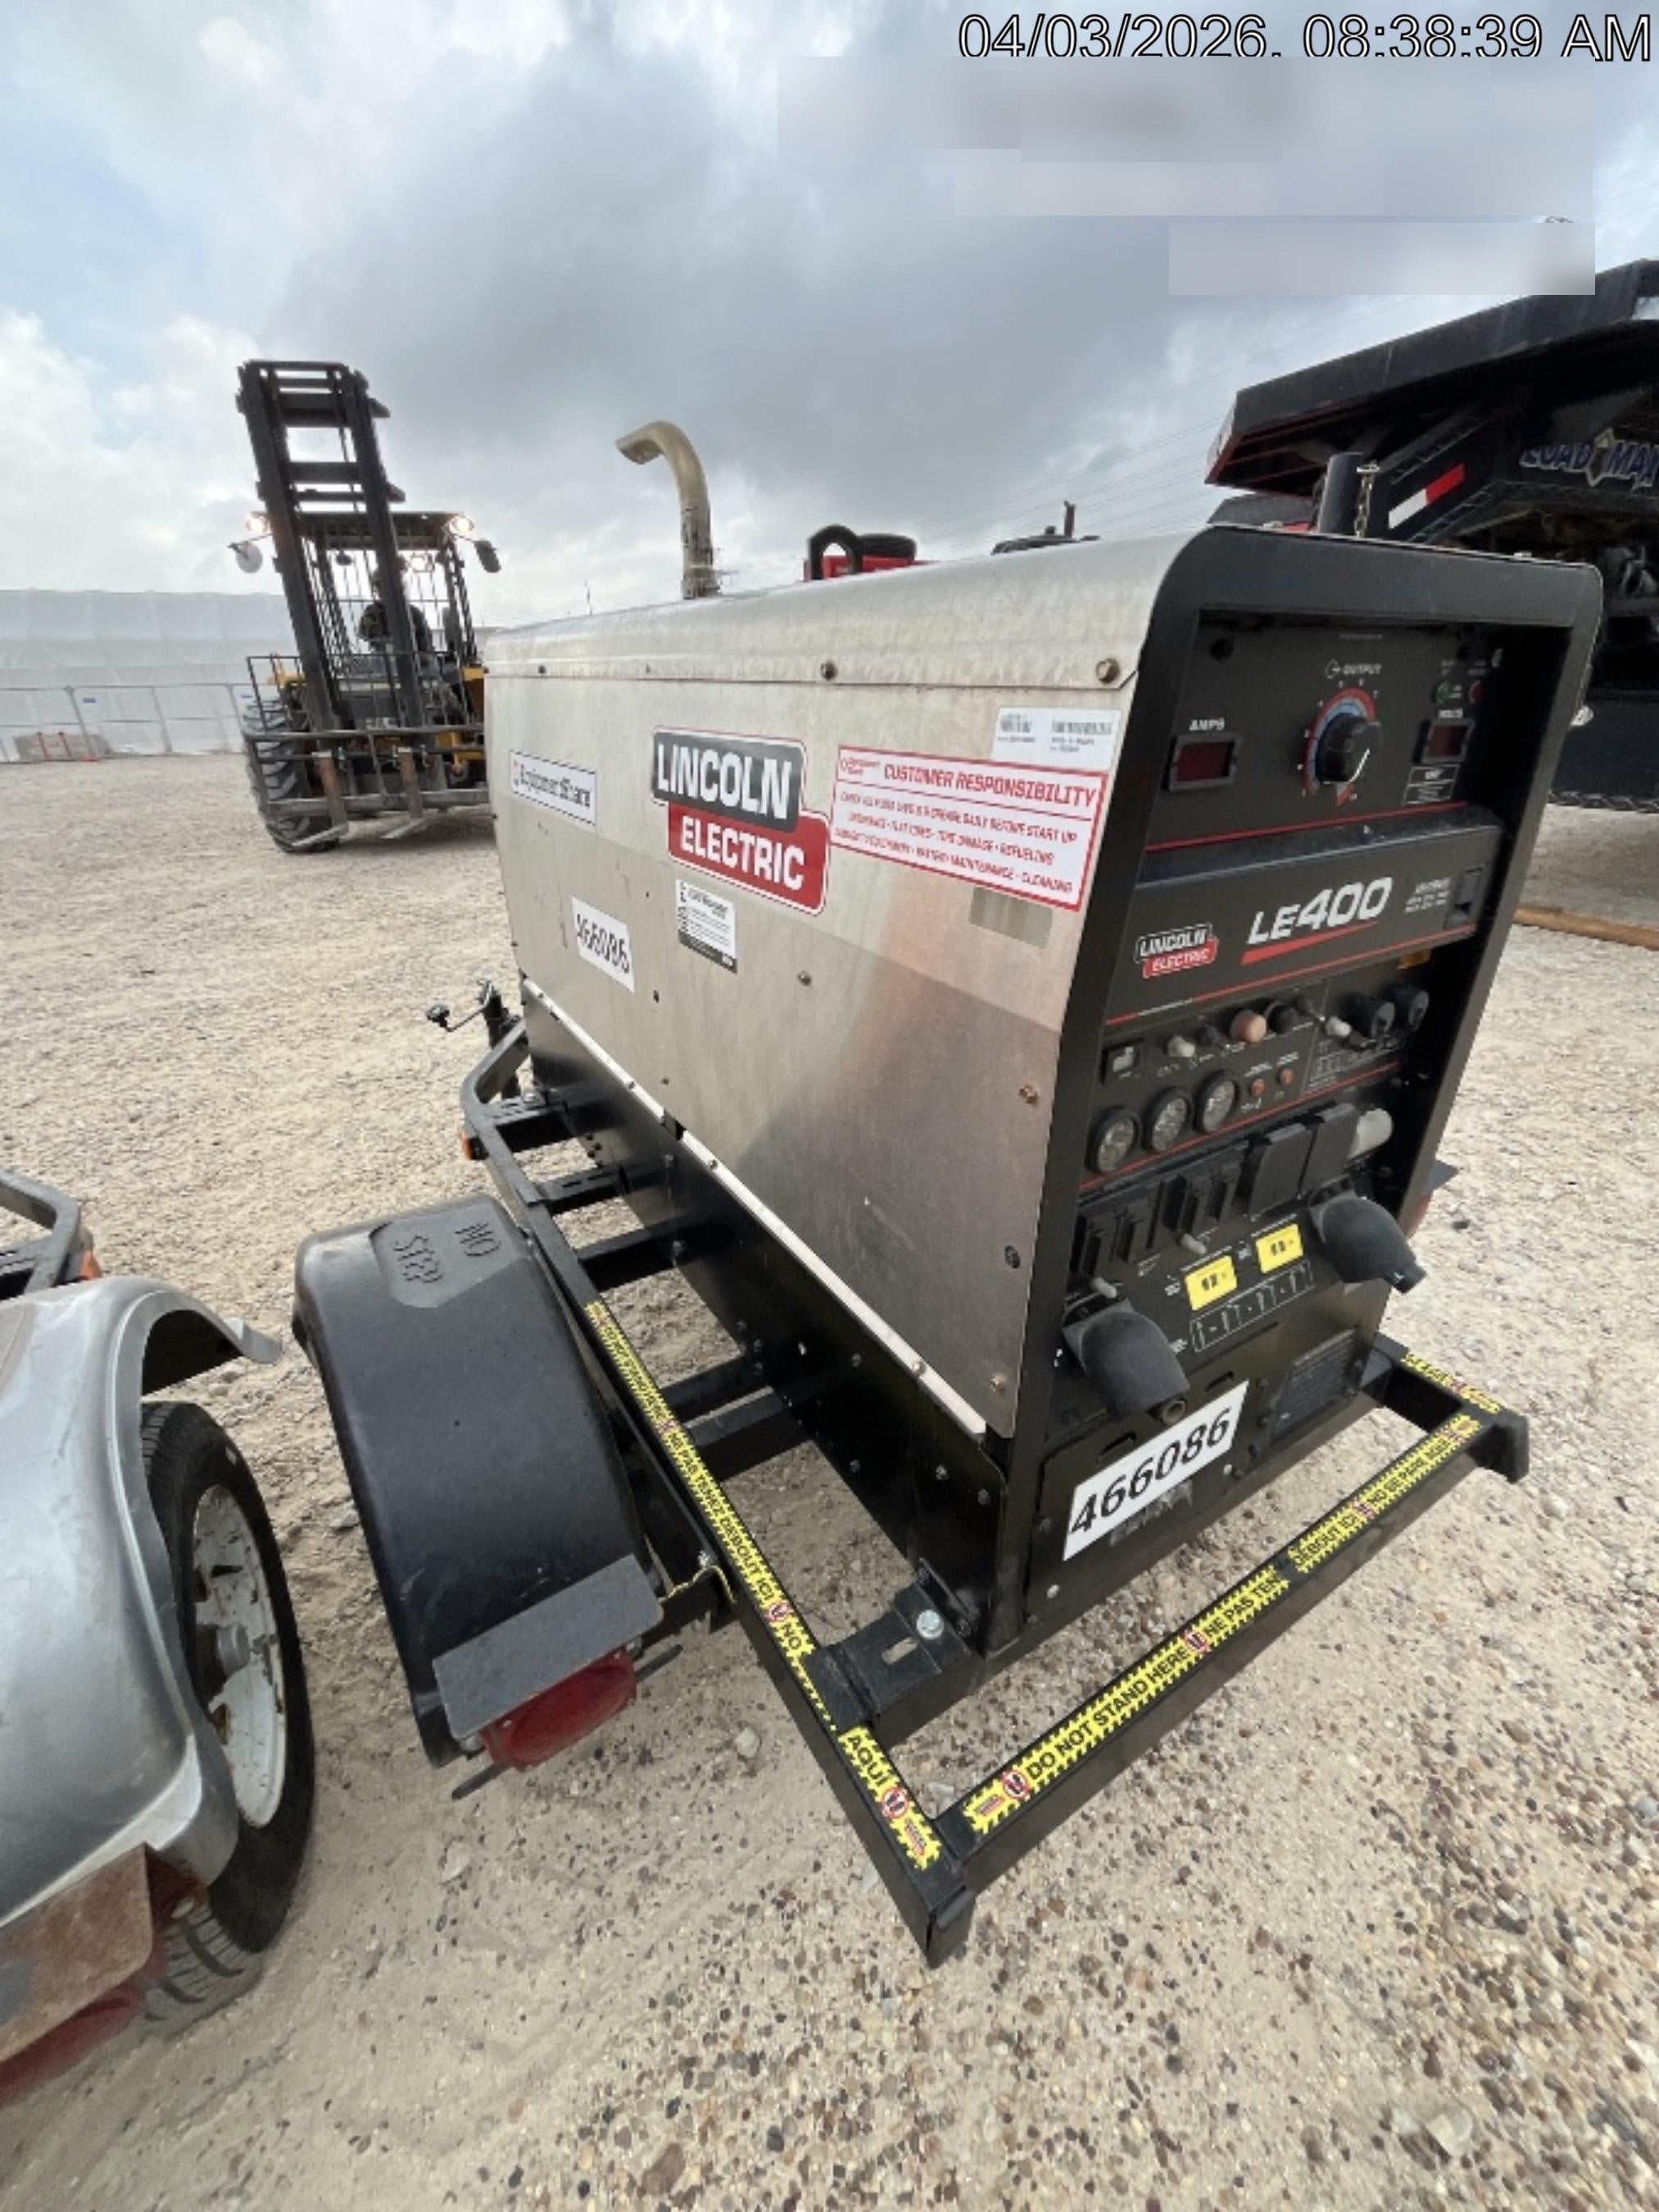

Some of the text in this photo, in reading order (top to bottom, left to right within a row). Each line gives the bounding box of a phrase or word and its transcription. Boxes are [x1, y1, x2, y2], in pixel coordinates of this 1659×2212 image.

[1189, 717, 1226, 732] AMPS
[657, 743, 792, 820] LINCOLN
[884, 764, 1096, 807] CUSTOMER RESPONSIBILITY
[681, 815, 805, 891] ELECTRIC
[1027, 825, 1059, 842] START
[1246, 877, 1393, 945] LE400
[576, 913, 630, 974] 466086
[1140, 929, 1208, 958] LINCOLN
[1151, 948, 1211, 972] ELECTRIC
[1070, 1407, 1232, 1534] 466086
[719, 1517, 760, 1576] DEBOUT
[756, 1577, 774, 1600] ICI
[781, 1624, 802, 1650] NO
[1204, 1616, 1228, 1637] NE
[1223, 1597, 1255, 1622] PAS
[1027, 1645, 1190, 1779] DO NOT STAND HERE
